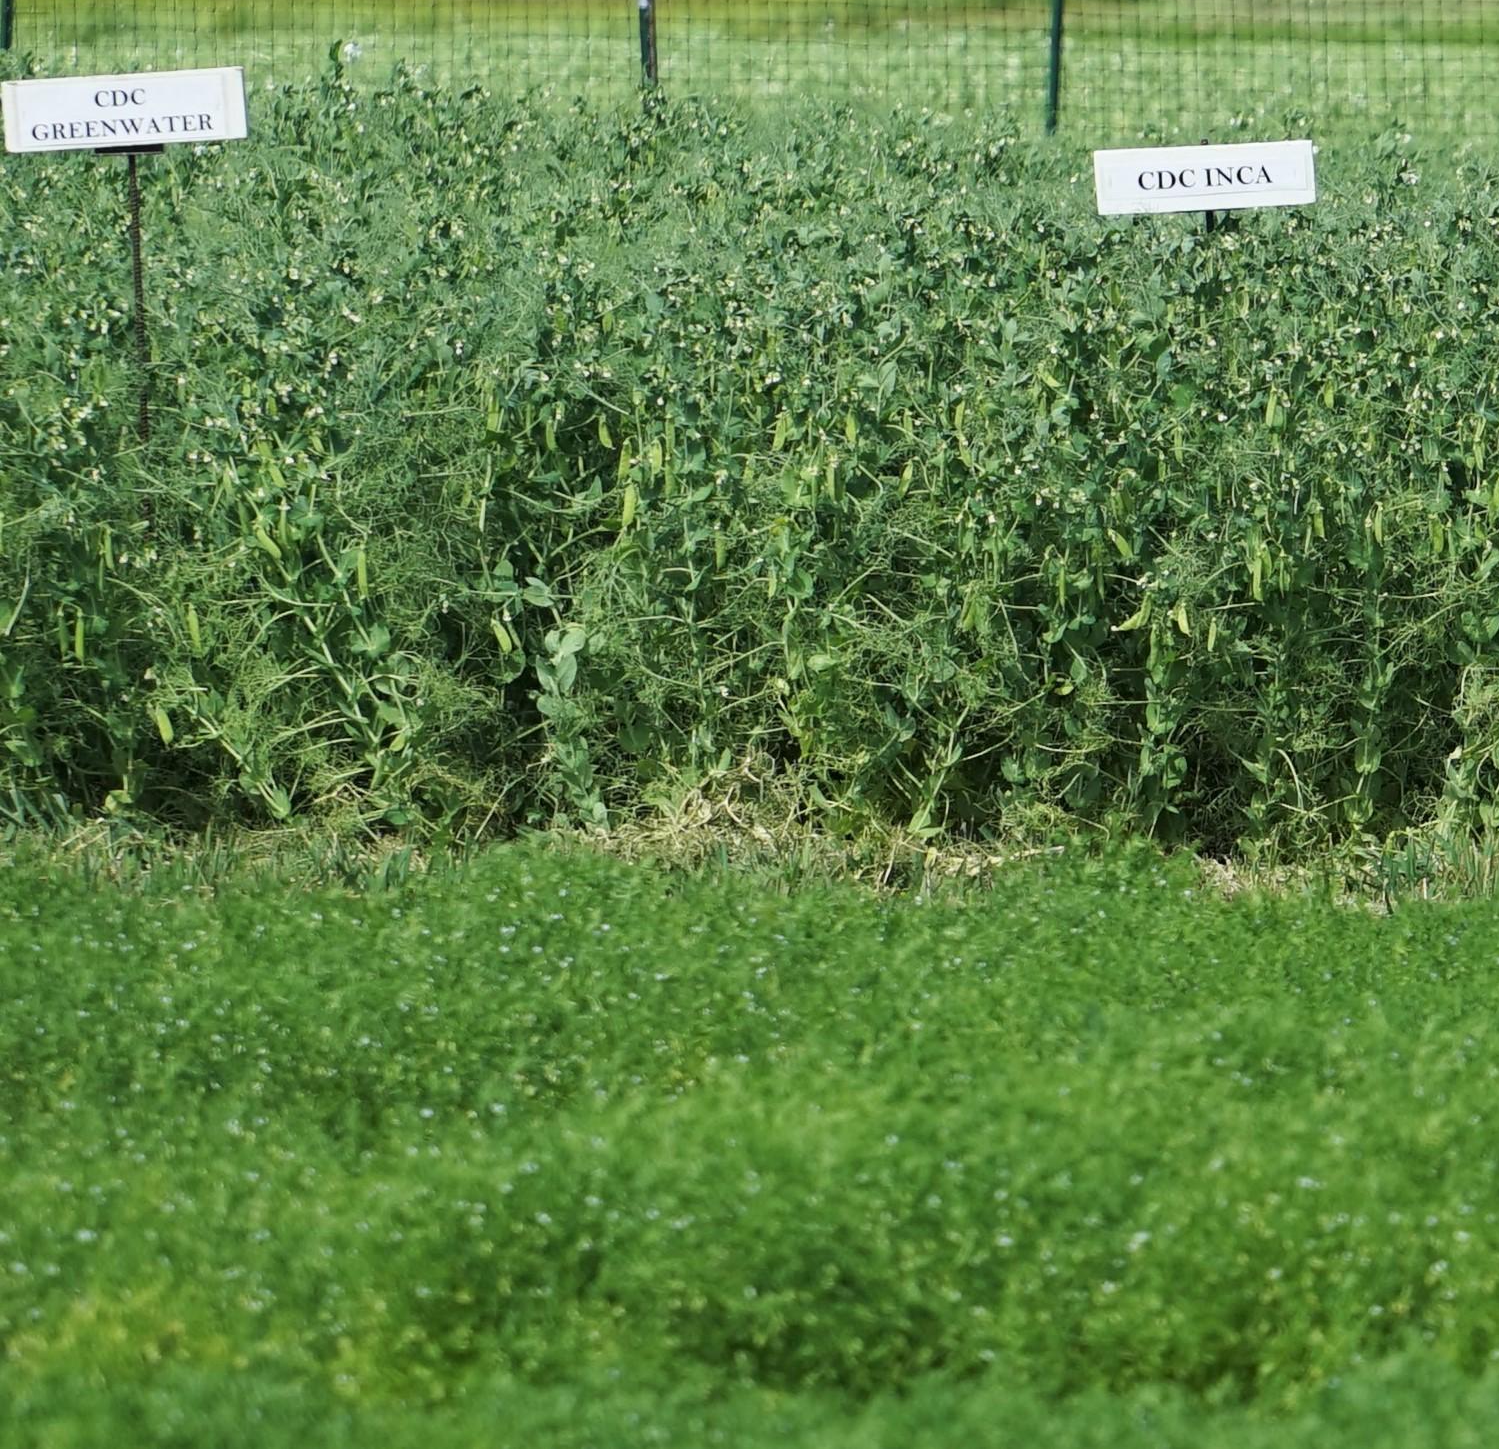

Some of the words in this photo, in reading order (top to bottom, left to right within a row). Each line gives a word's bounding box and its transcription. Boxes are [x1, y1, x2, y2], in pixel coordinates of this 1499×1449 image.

[93, 89, 147, 108] CDC
[31, 113, 214, 142] GREENWATER
[1136, 169, 1197, 191] CDC
[1203, 165, 1274, 188] INCA
